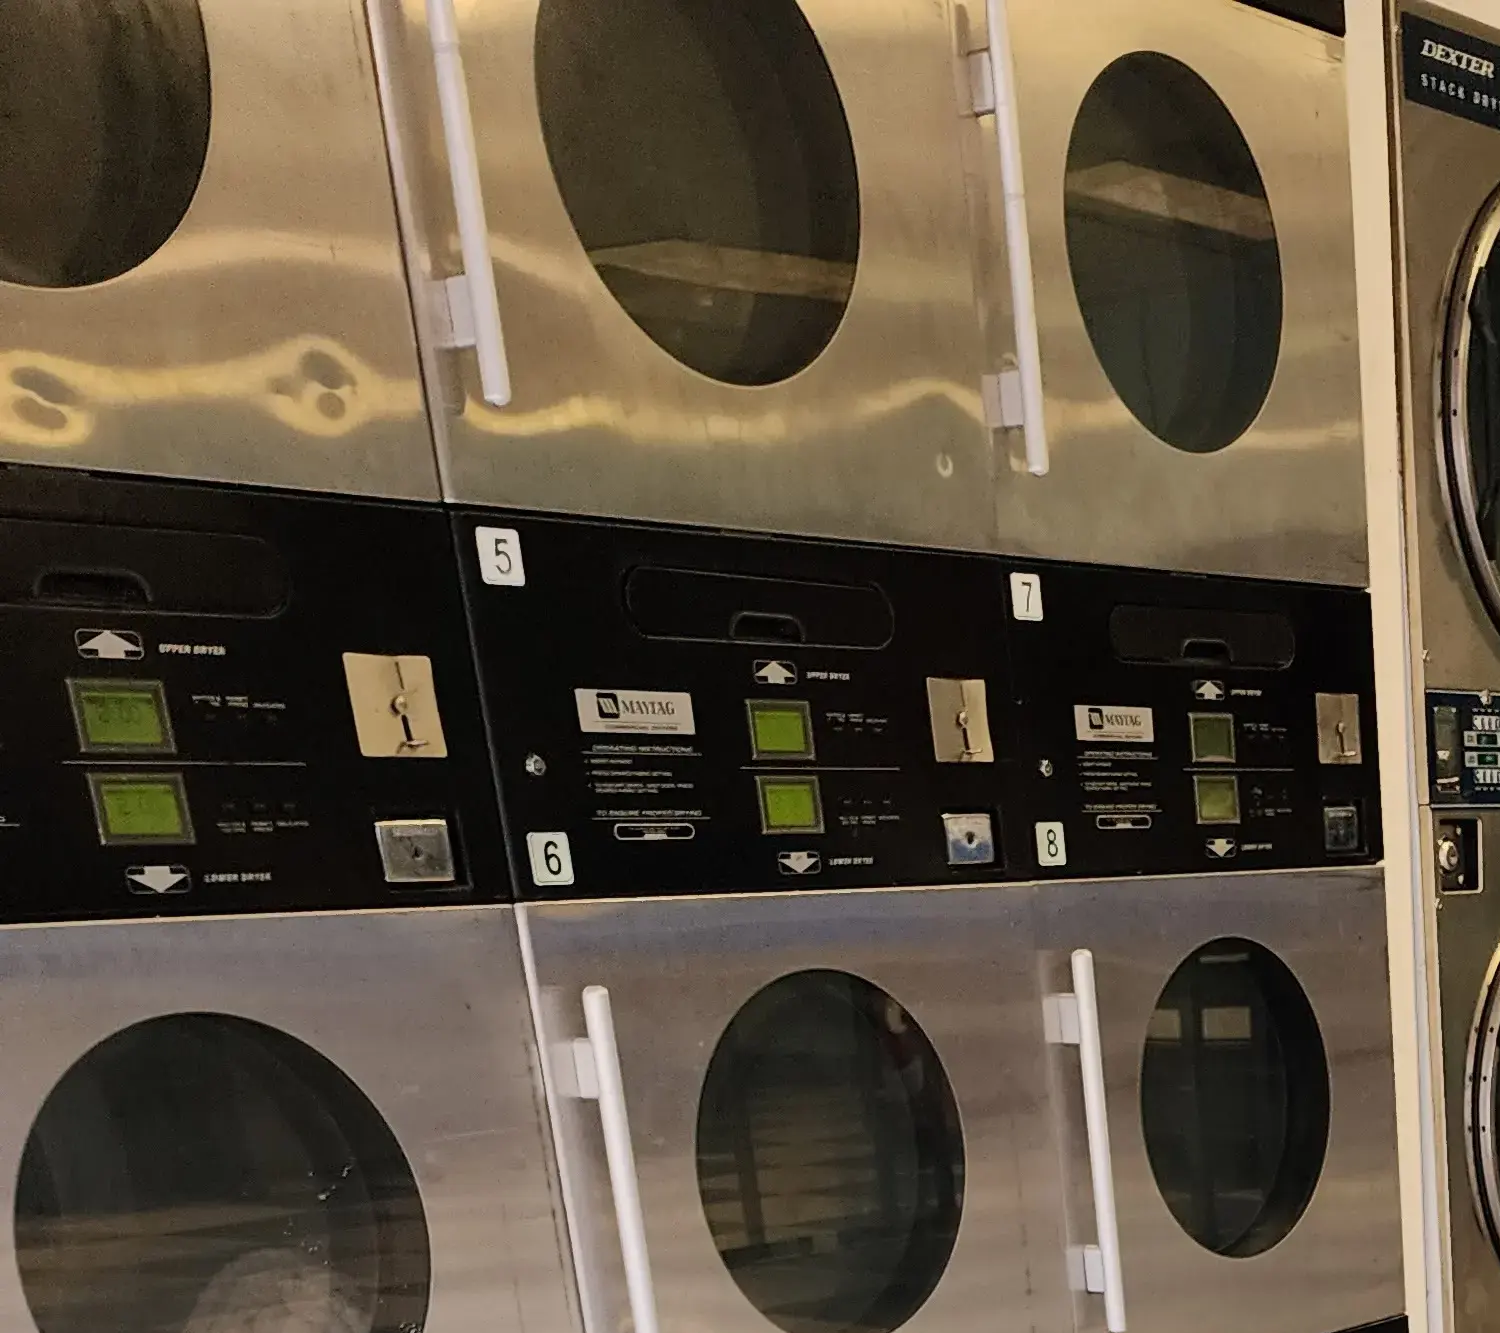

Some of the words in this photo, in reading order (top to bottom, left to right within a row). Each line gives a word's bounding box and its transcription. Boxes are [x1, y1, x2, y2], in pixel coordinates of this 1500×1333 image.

[1420, 39, 1496, 79] DEXTER
[1420, 73, 1465, 100] STACK
[493, 538, 513, 573] 5
[1020, 581, 1033, 613] 7
[159, 643, 191, 654] UPPER
[621, 699, 675, 716] MAYTAG
[1105, 714, 1142, 728] MAYTAG
[543, 841, 561, 875] 6
[1047, 829, 1060, 859] 8
